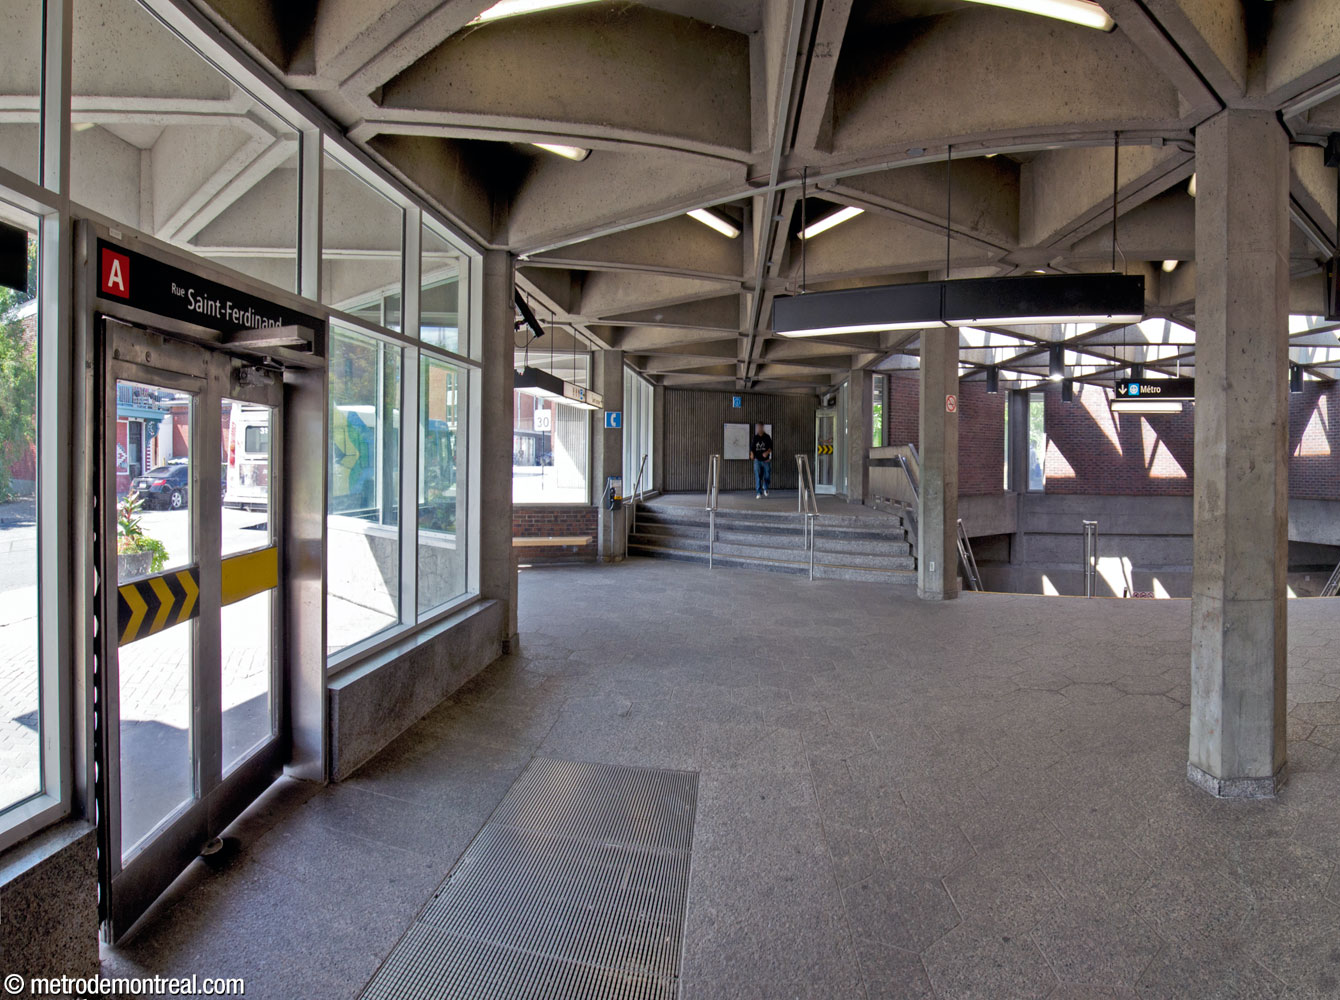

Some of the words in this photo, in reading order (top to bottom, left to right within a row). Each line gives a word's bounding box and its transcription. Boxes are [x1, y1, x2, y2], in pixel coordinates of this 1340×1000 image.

[108, 258, 125, 292] A
[171, 282, 186, 298] Rue
[1140, 384, 1161, 394] Métro
[537, 416, 550, 428] 30
